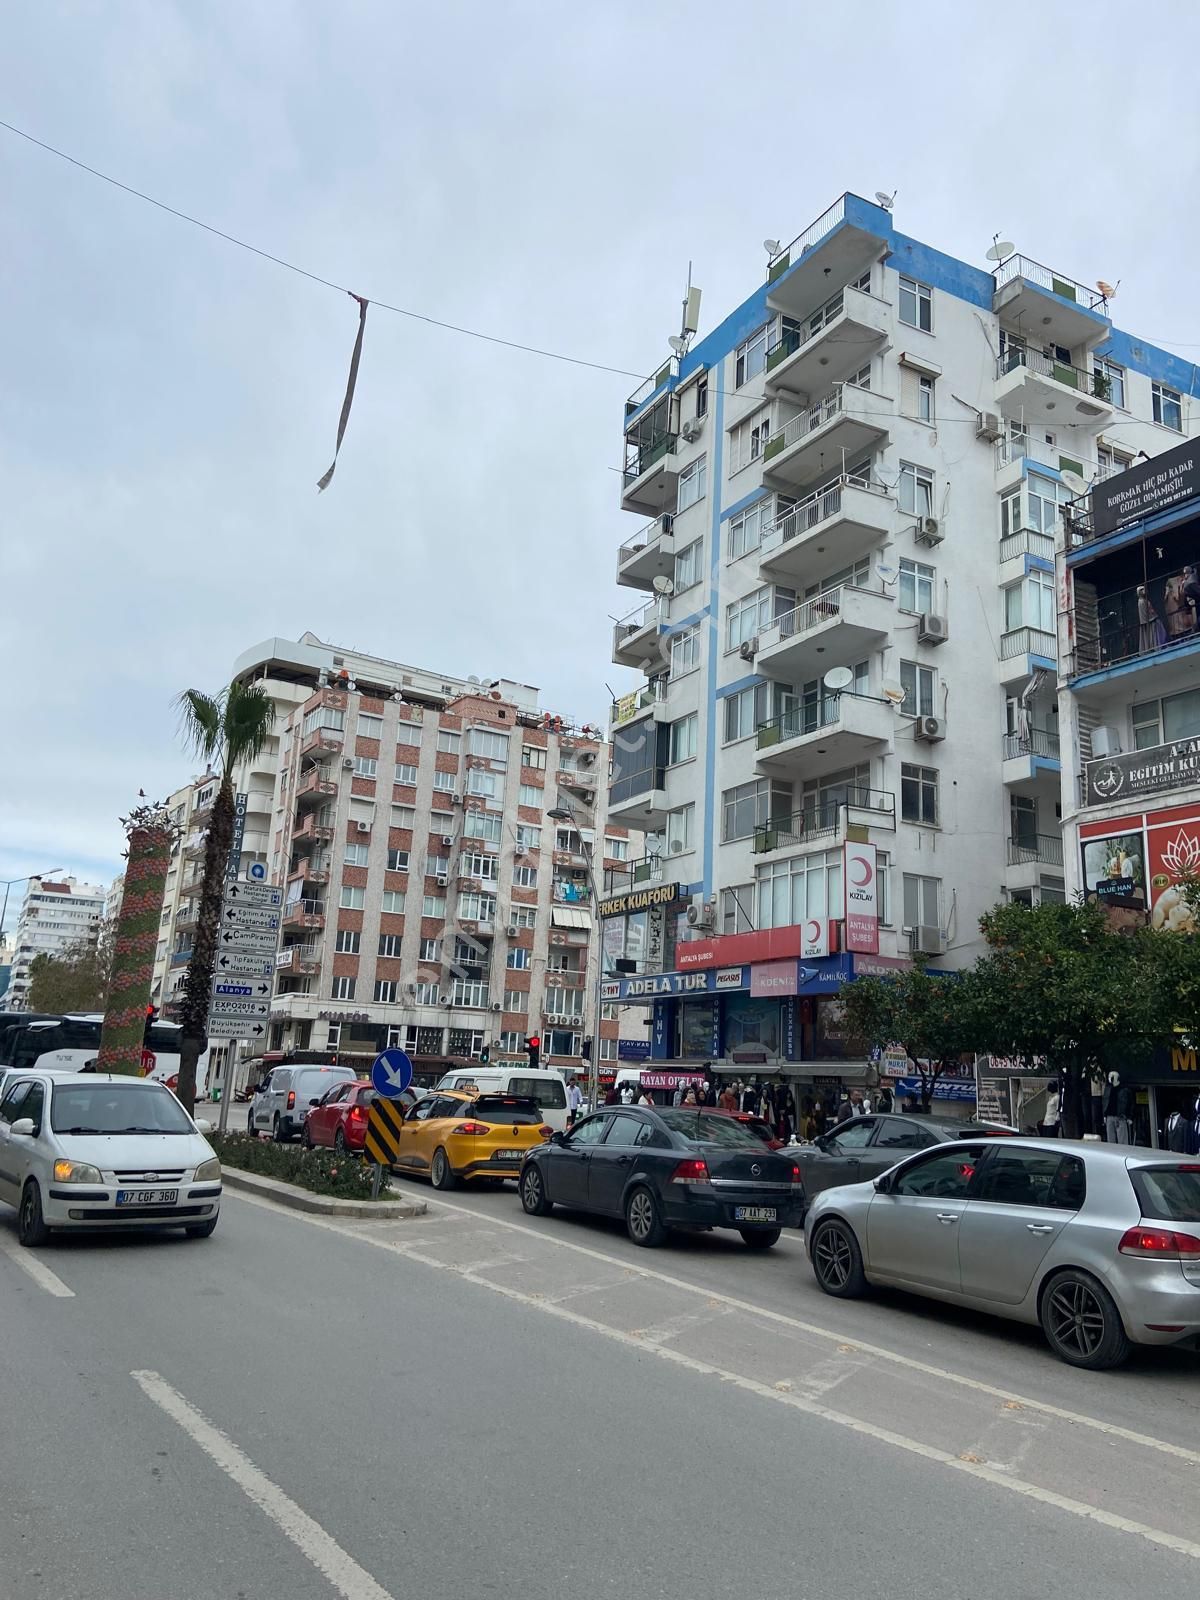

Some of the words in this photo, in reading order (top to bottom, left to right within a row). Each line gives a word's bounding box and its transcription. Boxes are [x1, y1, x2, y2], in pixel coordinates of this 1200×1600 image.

[1107, 484, 1142, 508] KORKMAK
[1156, 471, 1167, 485] BU
[1168, 459, 1194, 479] KADAR
[232, 794, 247, 850] HOTEL
[1098, 886, 1117, 895] BLUE
[1117, 884, 1132, 892] HAN
[849, 892, 873, 902] KIZILAY
[850, 920, 875, 932] ANTALYA
[805, 948, 822, 956] KIZILAY
[680, 954, 697, 963] ANTALYA
[230, 964, 263, 973] Hastanesi
[716, 972, 741, 983] PEGASUS
[607, 984, 619, 995] THY
[625, 977, 672, 997] ADELA
[673, 972, 708, 991] TUR
[218, 986, 251, 995] Alanya
[215, 1001, 256, 1010] EXPO2016
[318, 1010, 370, 1022] KUAFÖR
[210, 1028, 246, 1036] Belediyesi
[139, 1057, 154, 1069] UR
[640, 1075, 666, 1086] BAYAN
[123, 1192, 135, 1203] 07
[138, 1191, 155, 1202] CGF
[159, 1190, 175, 1202] 360
[739, 1207, 747, 1217] 07
[749, 1208, 760, 1217] AAT
[764, 1208, 776, 1218] 233
